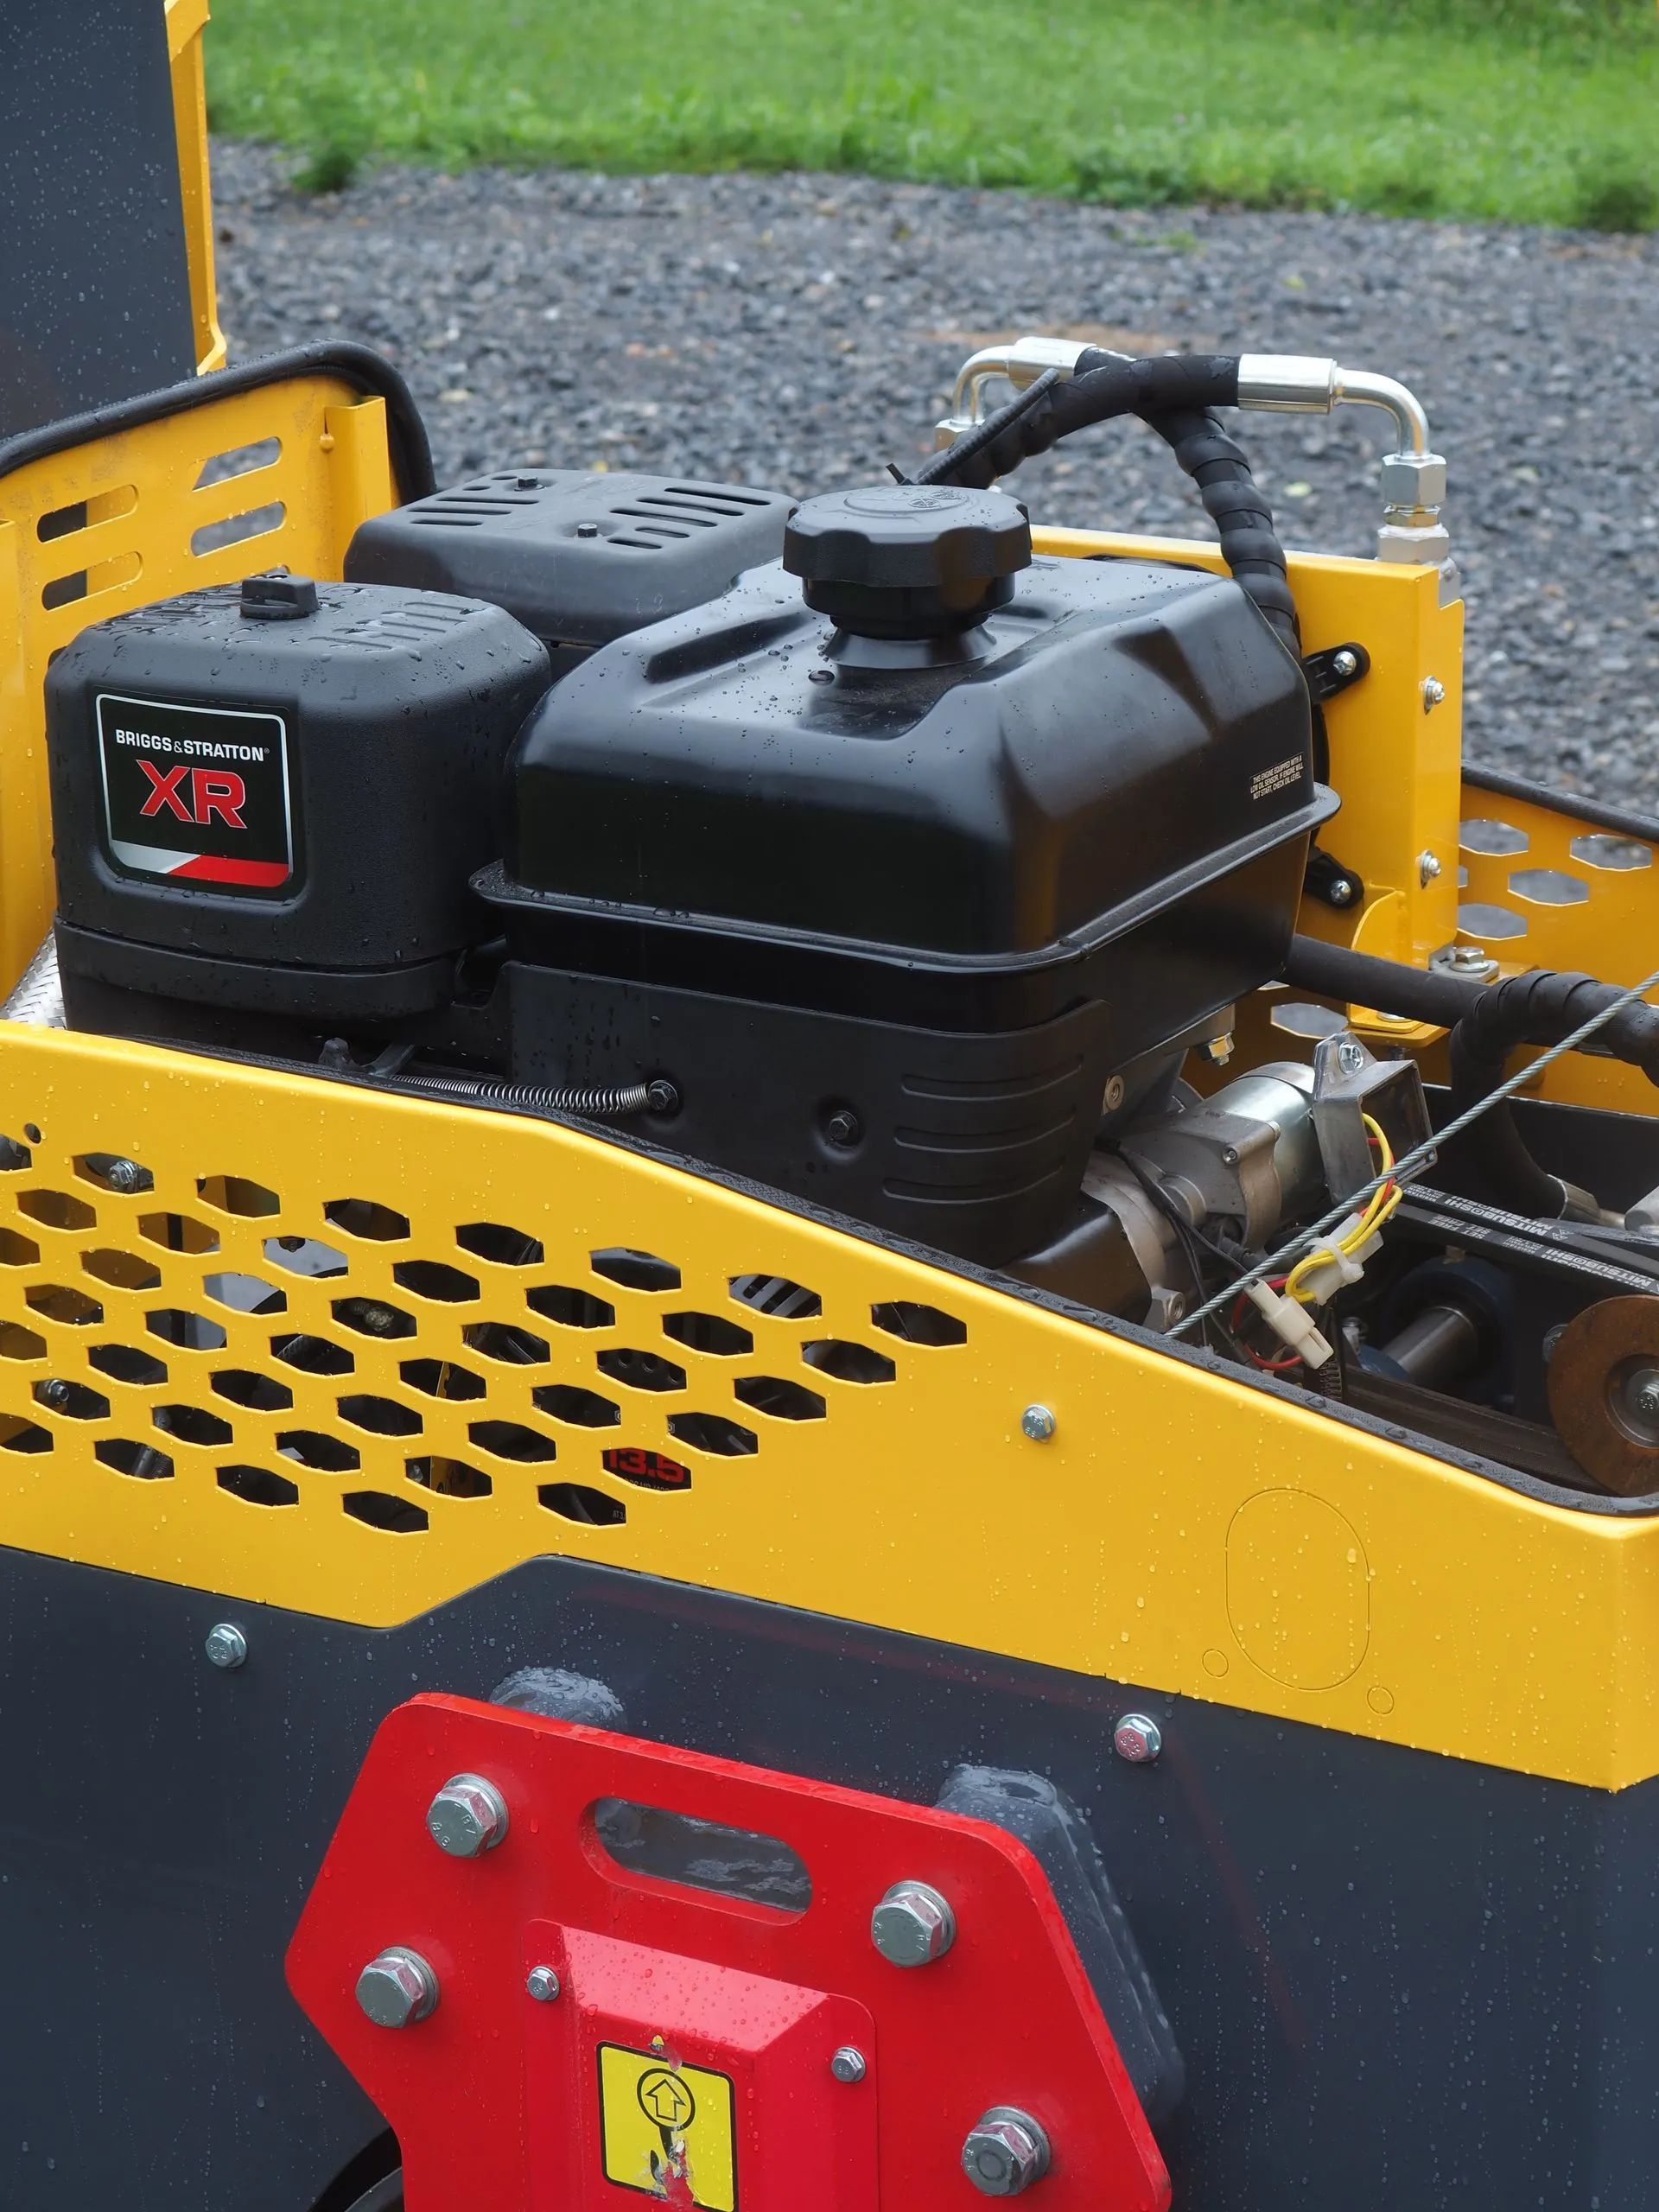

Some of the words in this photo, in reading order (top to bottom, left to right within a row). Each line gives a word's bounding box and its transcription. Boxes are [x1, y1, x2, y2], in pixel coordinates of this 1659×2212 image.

[1253, 775, 1262, 785] THIS
[136, 759, 248, 830] XR
[1427, 1218, 1459, 1231] FREE
[1444, 1198, 1548, 1236] MITSUBOSHI
[1460, 1230, 1485, 1240] SET
[1545, 1249, 1651, 1287] MITSUBOSHI
